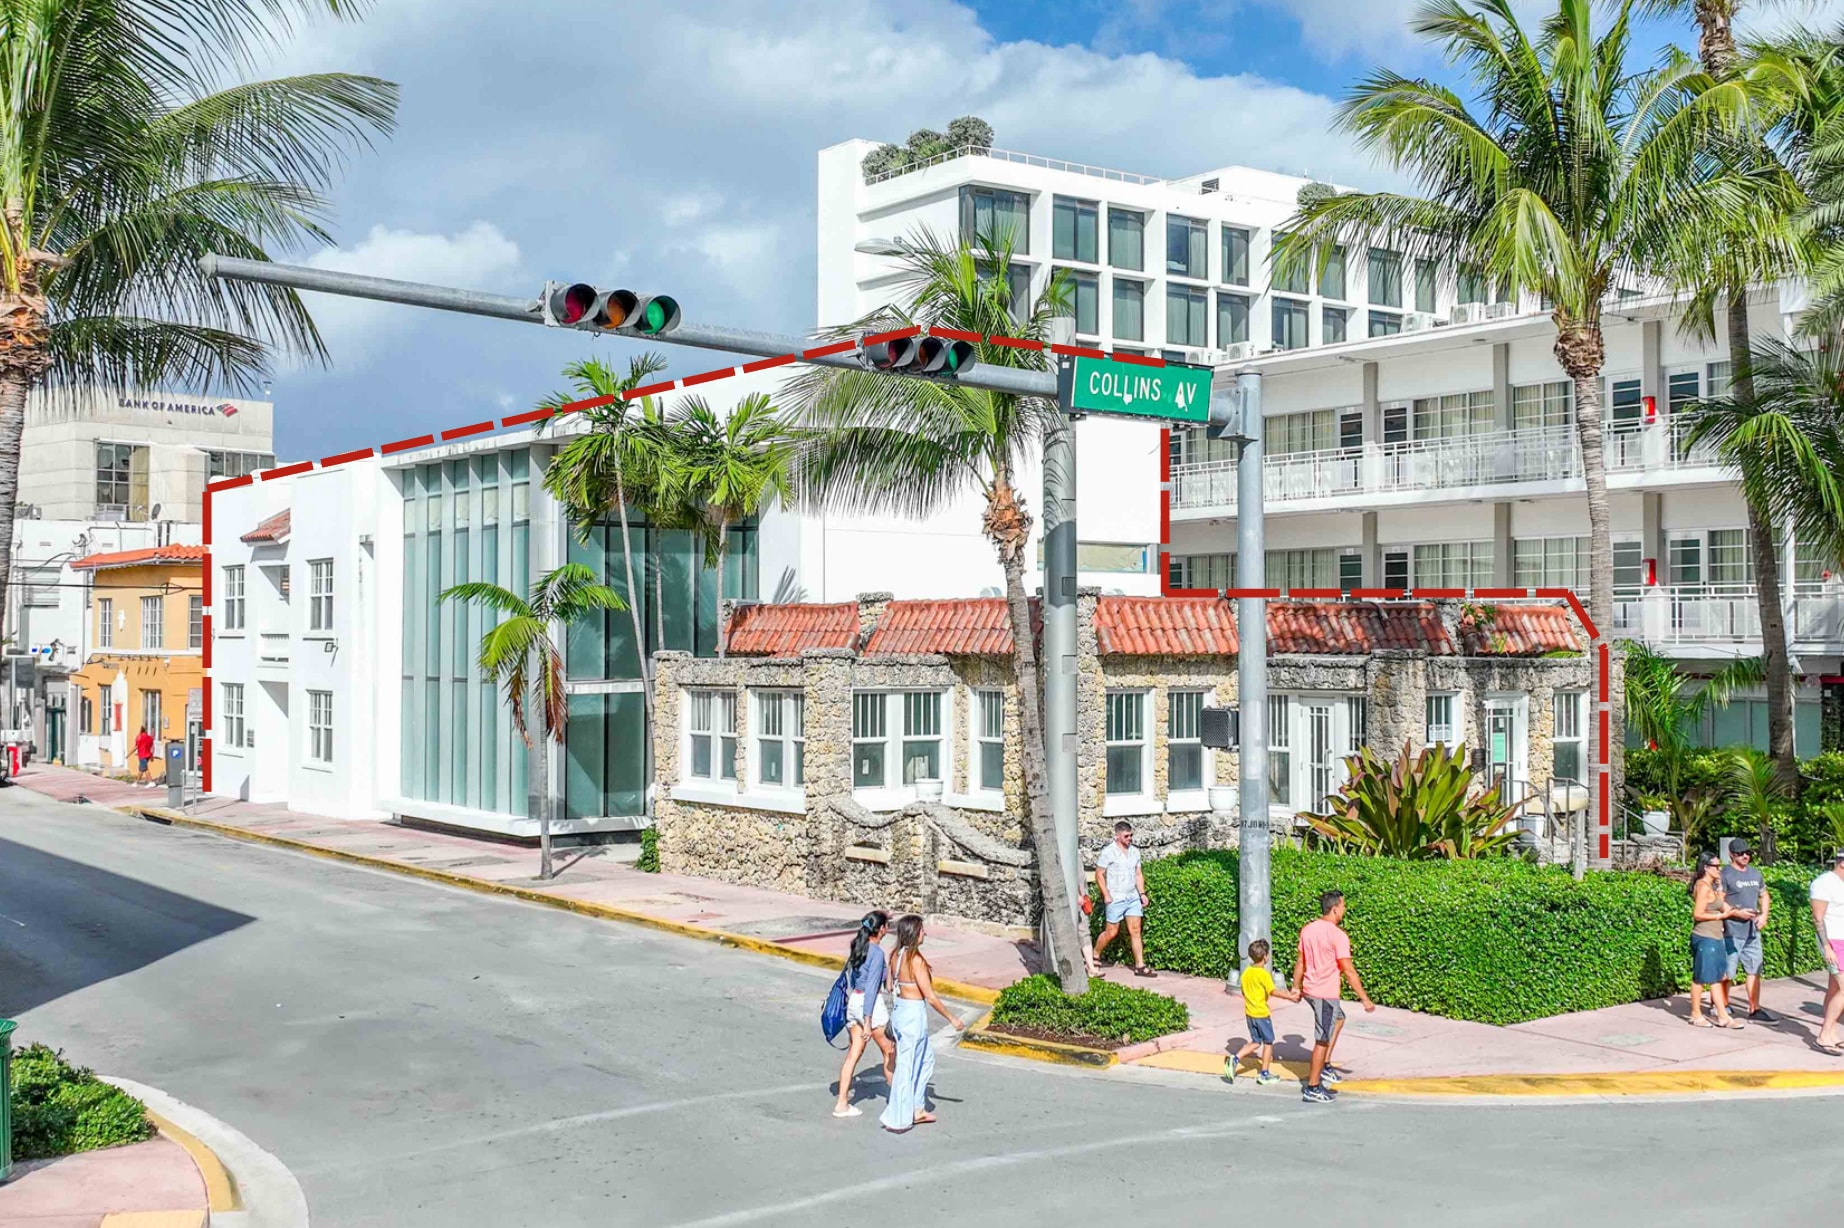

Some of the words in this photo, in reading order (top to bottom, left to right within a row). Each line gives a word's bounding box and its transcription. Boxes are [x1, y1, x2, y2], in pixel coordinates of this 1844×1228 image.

[1089, 371, 1162, 402] COLLINS
[1174, 382, 1197, 408] AV
[119, 399, 149, 410] BANK
[151, 401, 166, 412] OF
[167, 403, 215, 416] AMERICA
